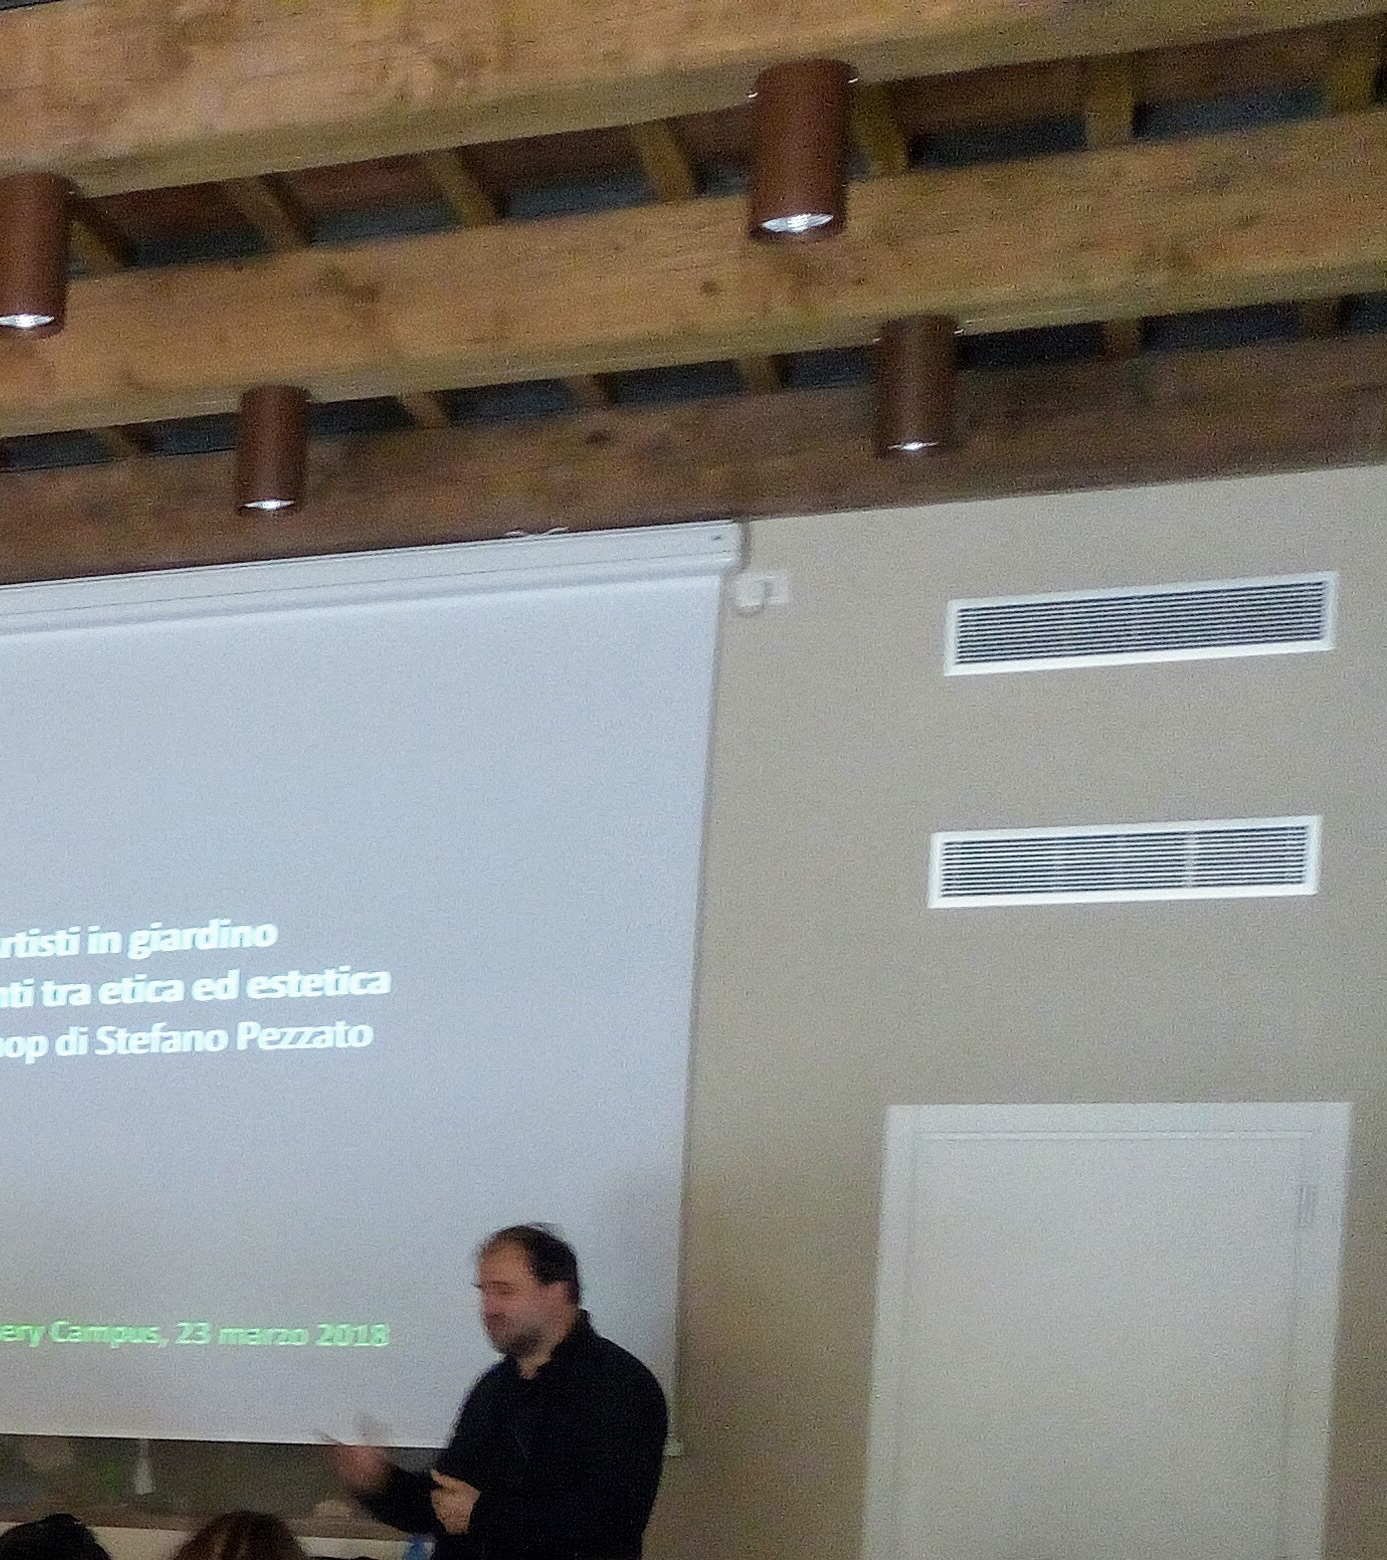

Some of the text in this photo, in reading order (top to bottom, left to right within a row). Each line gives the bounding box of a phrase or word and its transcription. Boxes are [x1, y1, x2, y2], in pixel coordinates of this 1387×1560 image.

[87, 924, 121, 956] in
[128, 919, 278, 960] giardino
[42, 979, 91, 1005] tra
[99, 973, 184, 1004] etica
[192, 969, 240, 1002] ed
[247, 966, 392, 1000] estetica
[55, 1026, 88, 1057] di
[95, 1021, 228, 1056] Stefano
[238, 1020, 373, 1051] Pezzato
[49, 1320, 169, 1348] Campus,
[175, 1322, 211, 1344] 23
[218, 1326, 308, 1346] marzo
[316, 1323, 390, 1347] 2018
